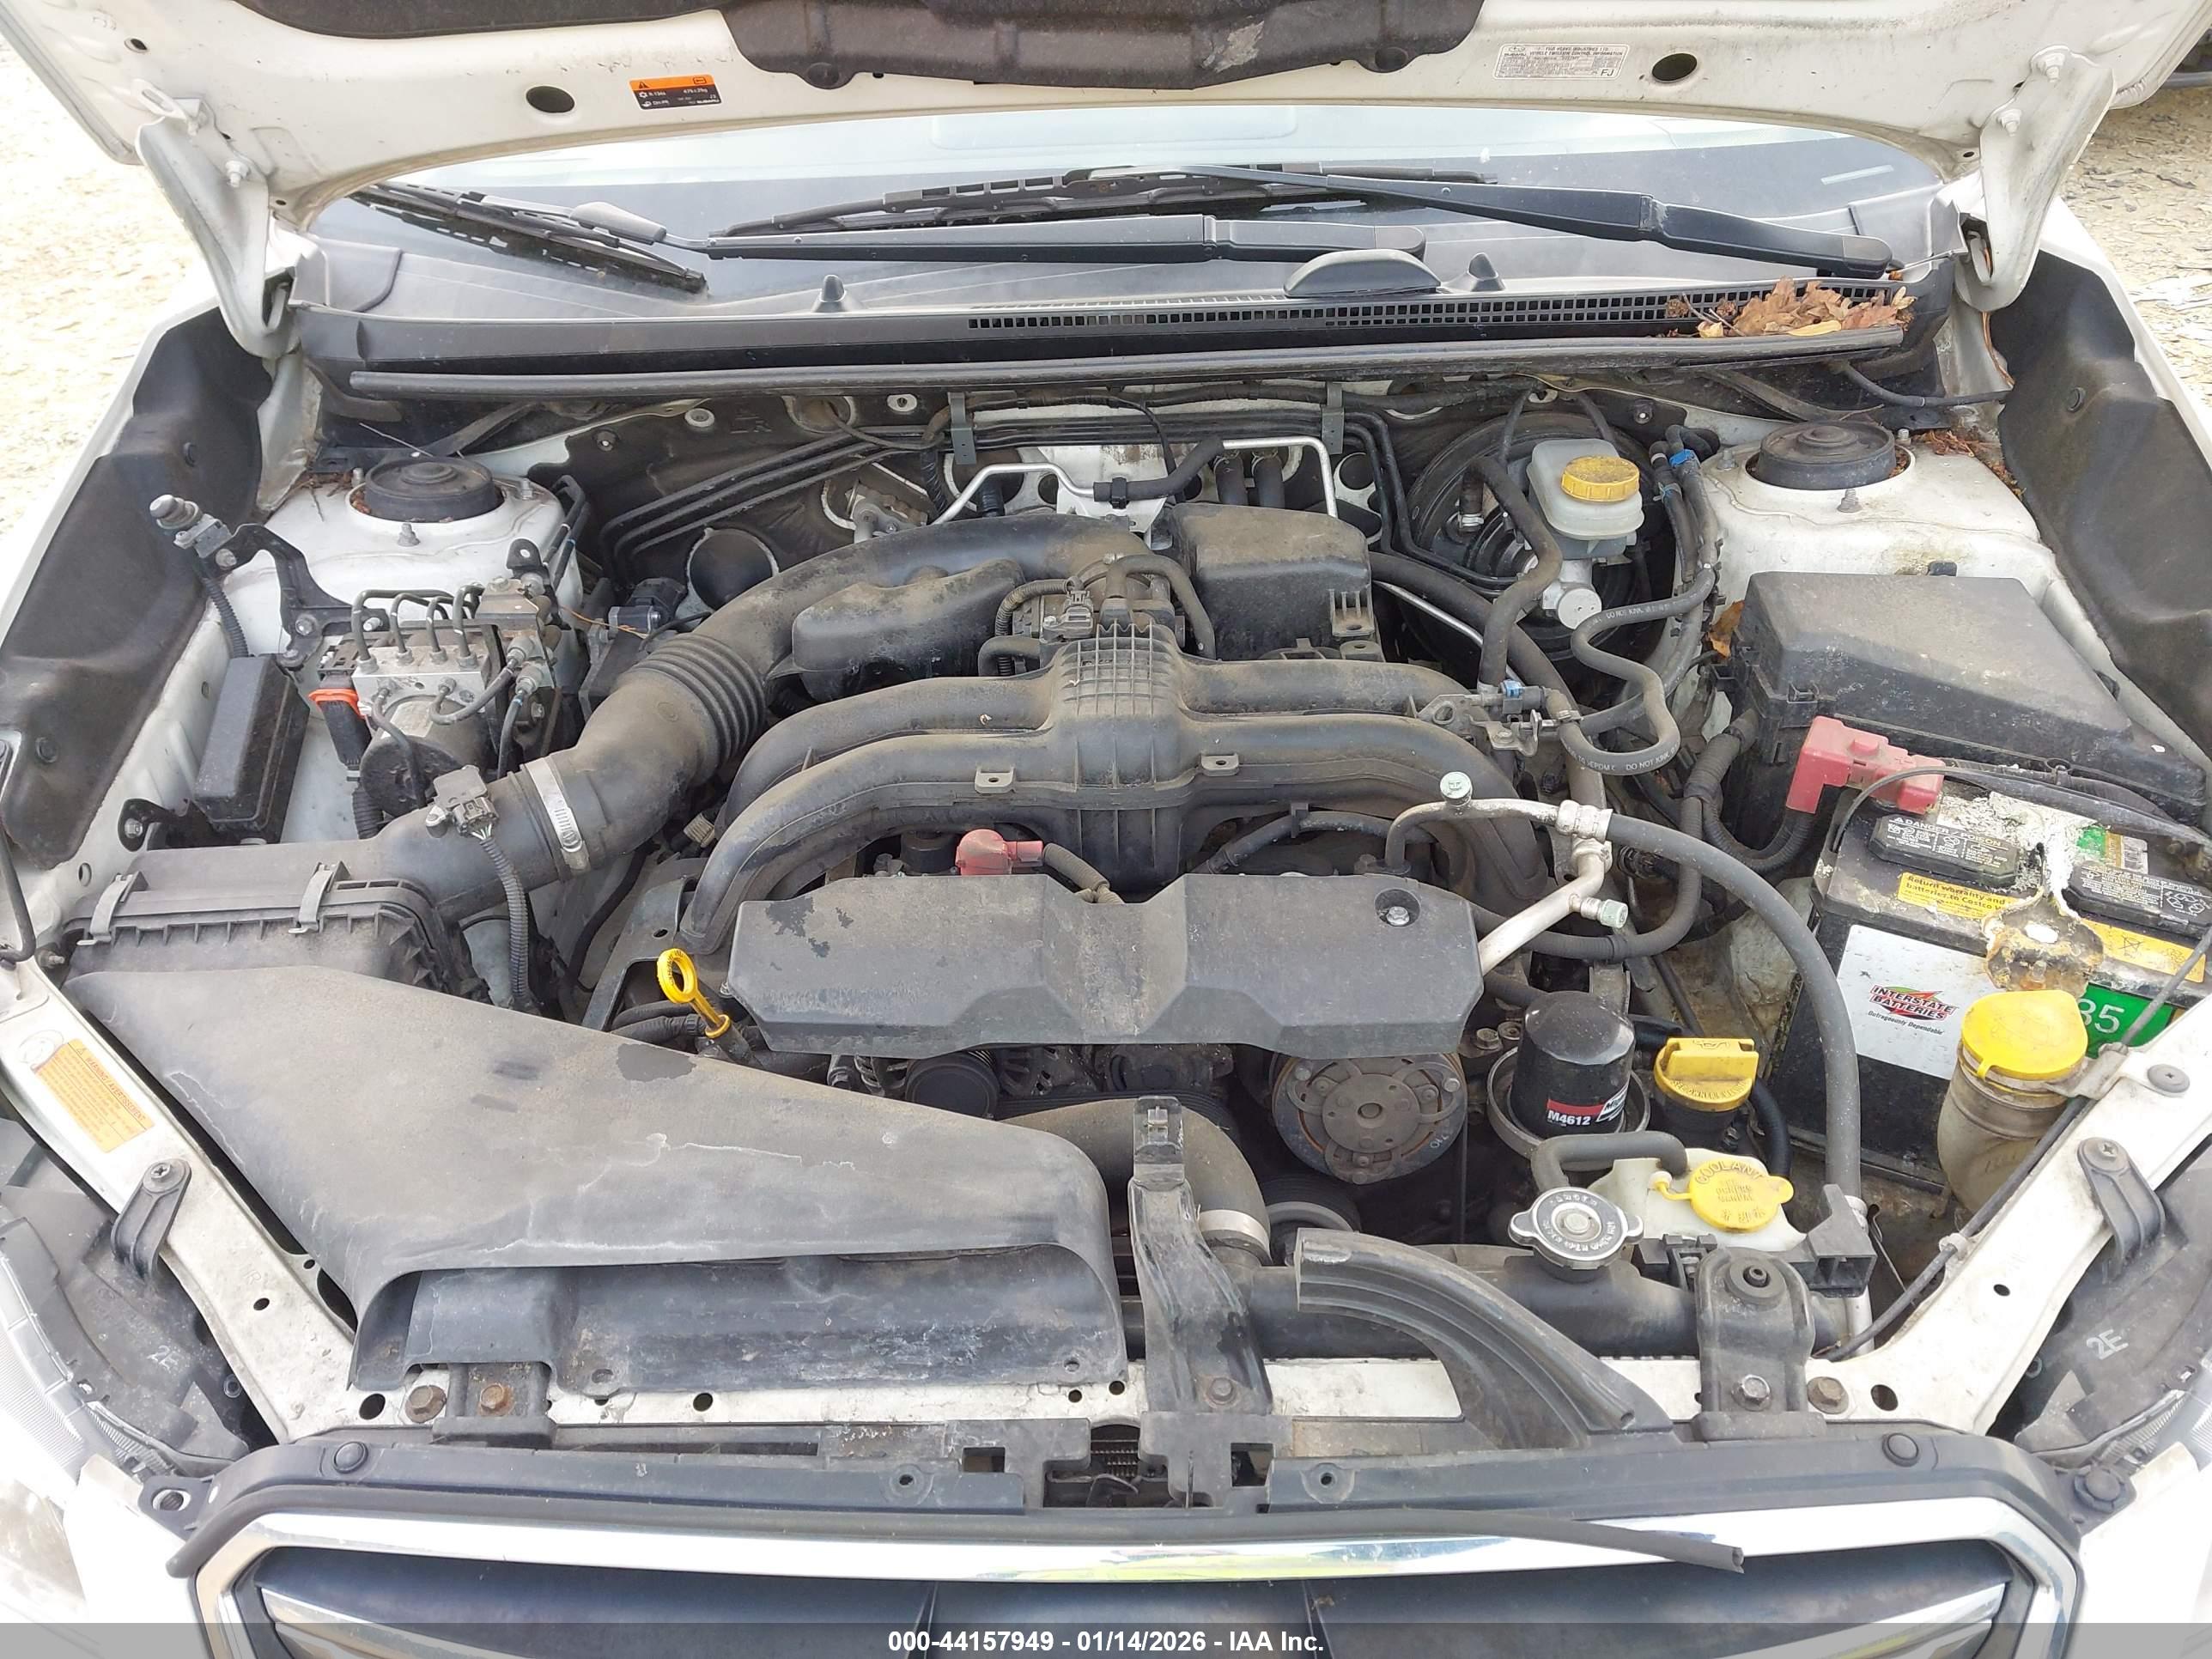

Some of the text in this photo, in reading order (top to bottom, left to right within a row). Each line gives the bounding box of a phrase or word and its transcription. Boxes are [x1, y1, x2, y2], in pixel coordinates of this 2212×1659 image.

[1639, 759, 1654, 769] NOT
[1905, 819, 1949, 834] DANGER
[1960, 832, 2002, 848] POISON
[1907, 875, 1940, 890] Return
[1986, 896, 2006, 905] and
[1961, 896, 1992, 910] Costco
[1873, 987, 1954, 1013] INTERSTATE
[1873, 995, 1945, 1020] BATTERIES
[1868, 1010, 1907, 1026] Outrageously
[1547, 1109, 1592, 1126] M4612
[1694, 1160, 1765, 1185] COOLANT
[2087, 1328, 2129, 1360] 2E
